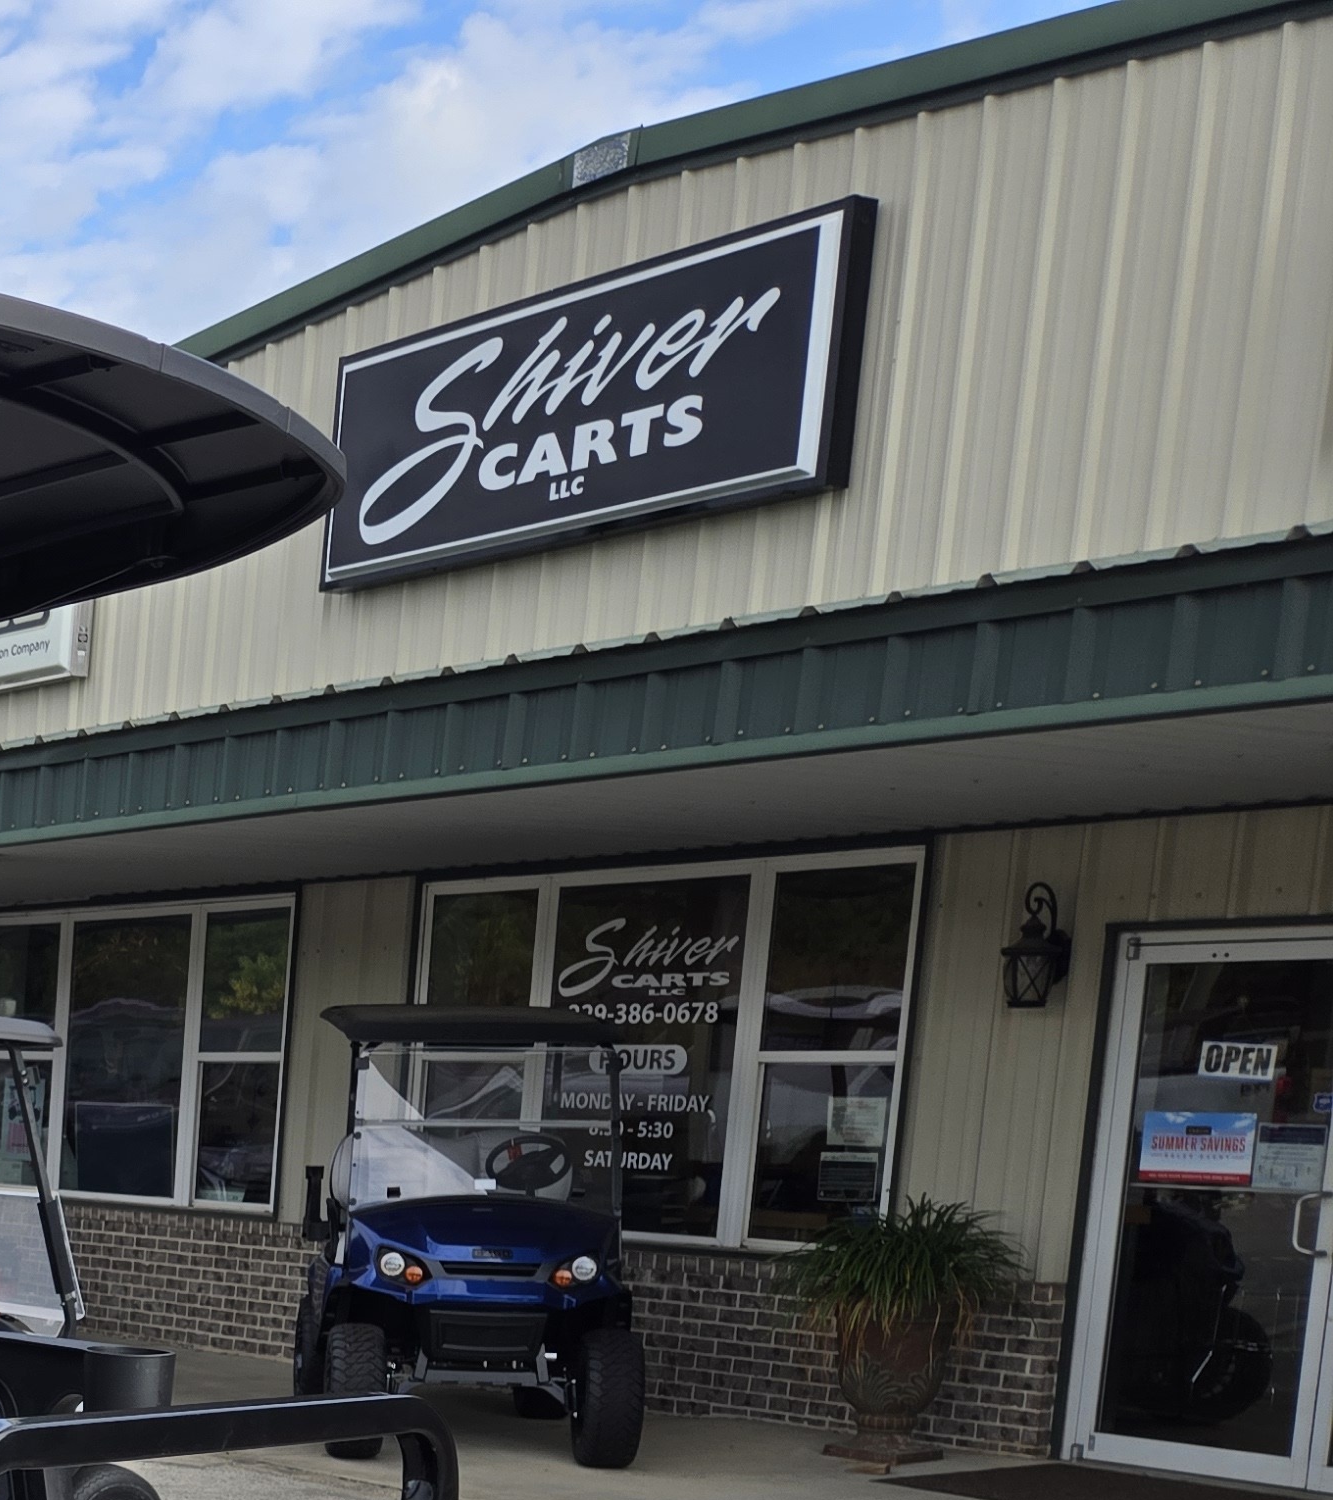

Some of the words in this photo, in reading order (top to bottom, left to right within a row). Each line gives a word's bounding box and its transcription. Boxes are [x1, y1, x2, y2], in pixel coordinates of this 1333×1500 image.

[359, 286, 781, 546] Shiver
[478, 393, 704, 491] CARTS
[548, 475, 586, 501] LLC
[11, 638, 51, 657] Company
[558, 917, 740, 998] Shiver
[611, 971, 730, 989] CARTS
[648, 988, 686, 996] LLC
[1204, 1044, 1272, 1077] OPEN
[647, 1094, 710, 1113] FRIDAY
[637, 1121, 674, 1139] 5:30
[1151, 1134, 1197, 1152] SUMMER
[1200, 1135, 1246, 1153] SAVINGS
